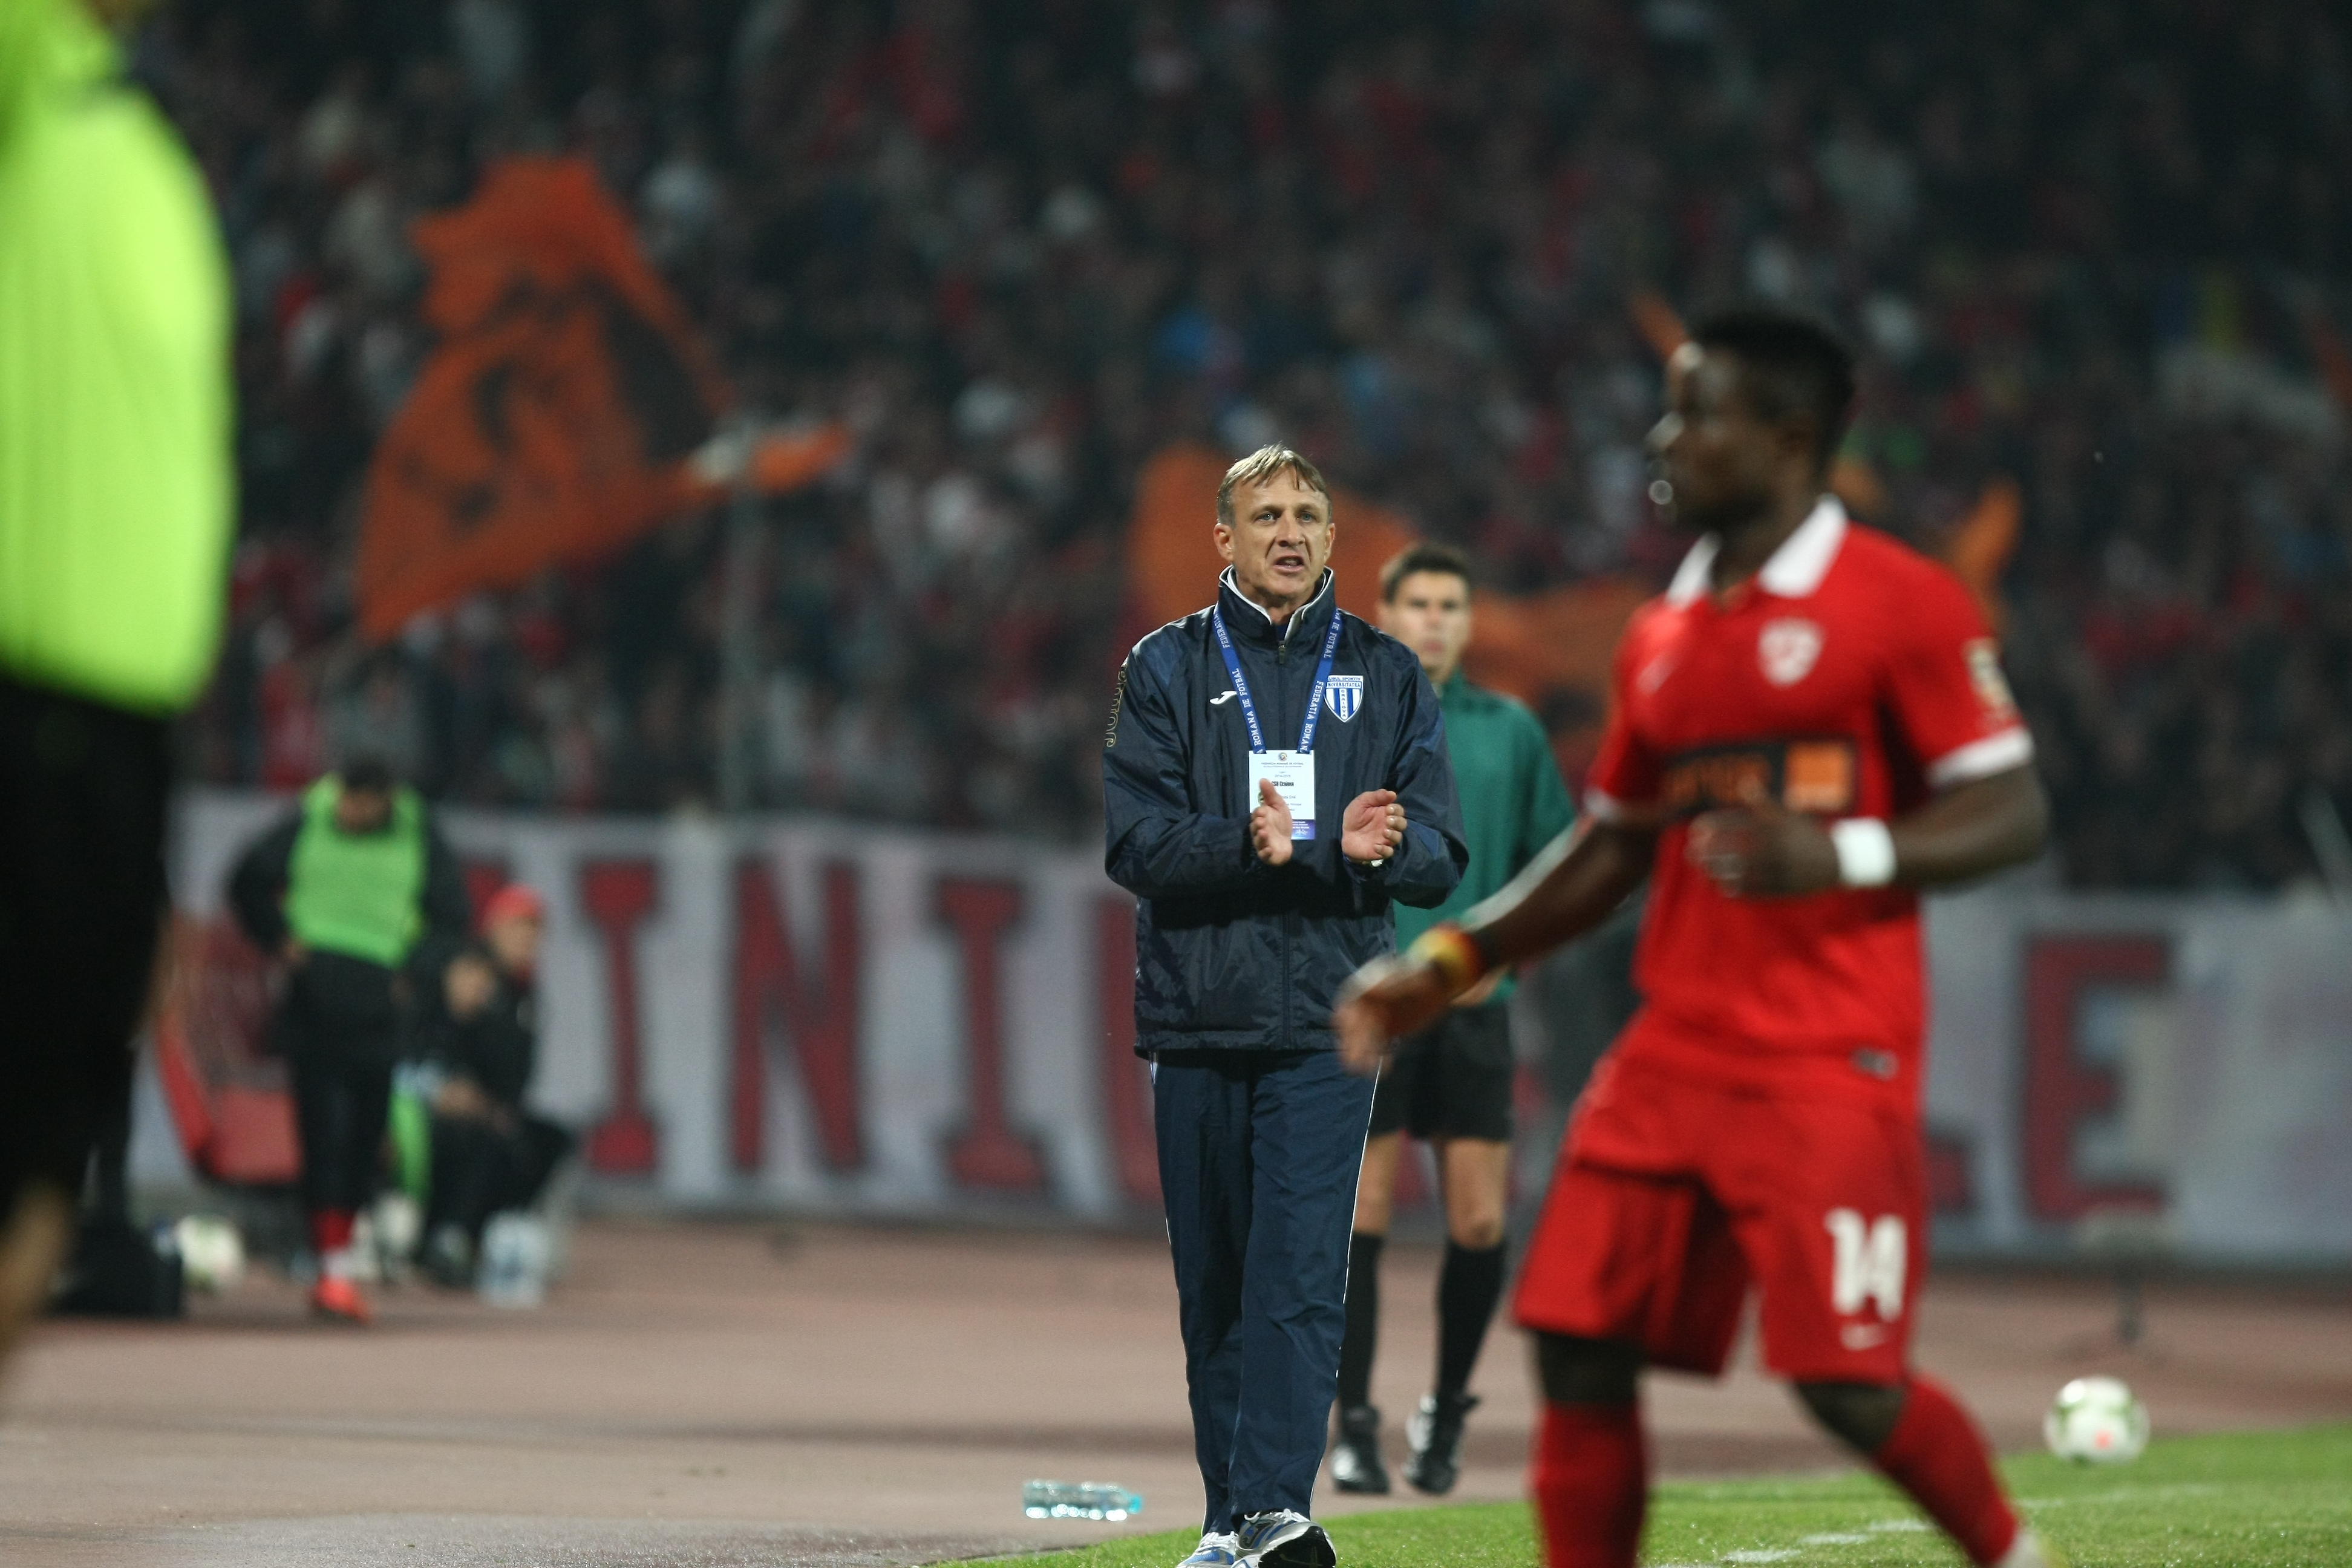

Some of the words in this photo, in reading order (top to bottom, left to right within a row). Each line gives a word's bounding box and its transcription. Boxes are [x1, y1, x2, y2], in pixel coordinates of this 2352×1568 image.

[1331, 622, 1339, 630] DE
[1324, 632, 1338, 658] FOTBAL
[1232, 668, 1247, 696] FOTBAL
[1242, 698, 1251, 708] DE
[1307, 681, 1324, 720] FEDERATIA
[1246, 710, 1262, 746] ROMANA
[1299, 723, 1313, 751] ROMAN
[1824, 1207, 1907, 1322] 14
